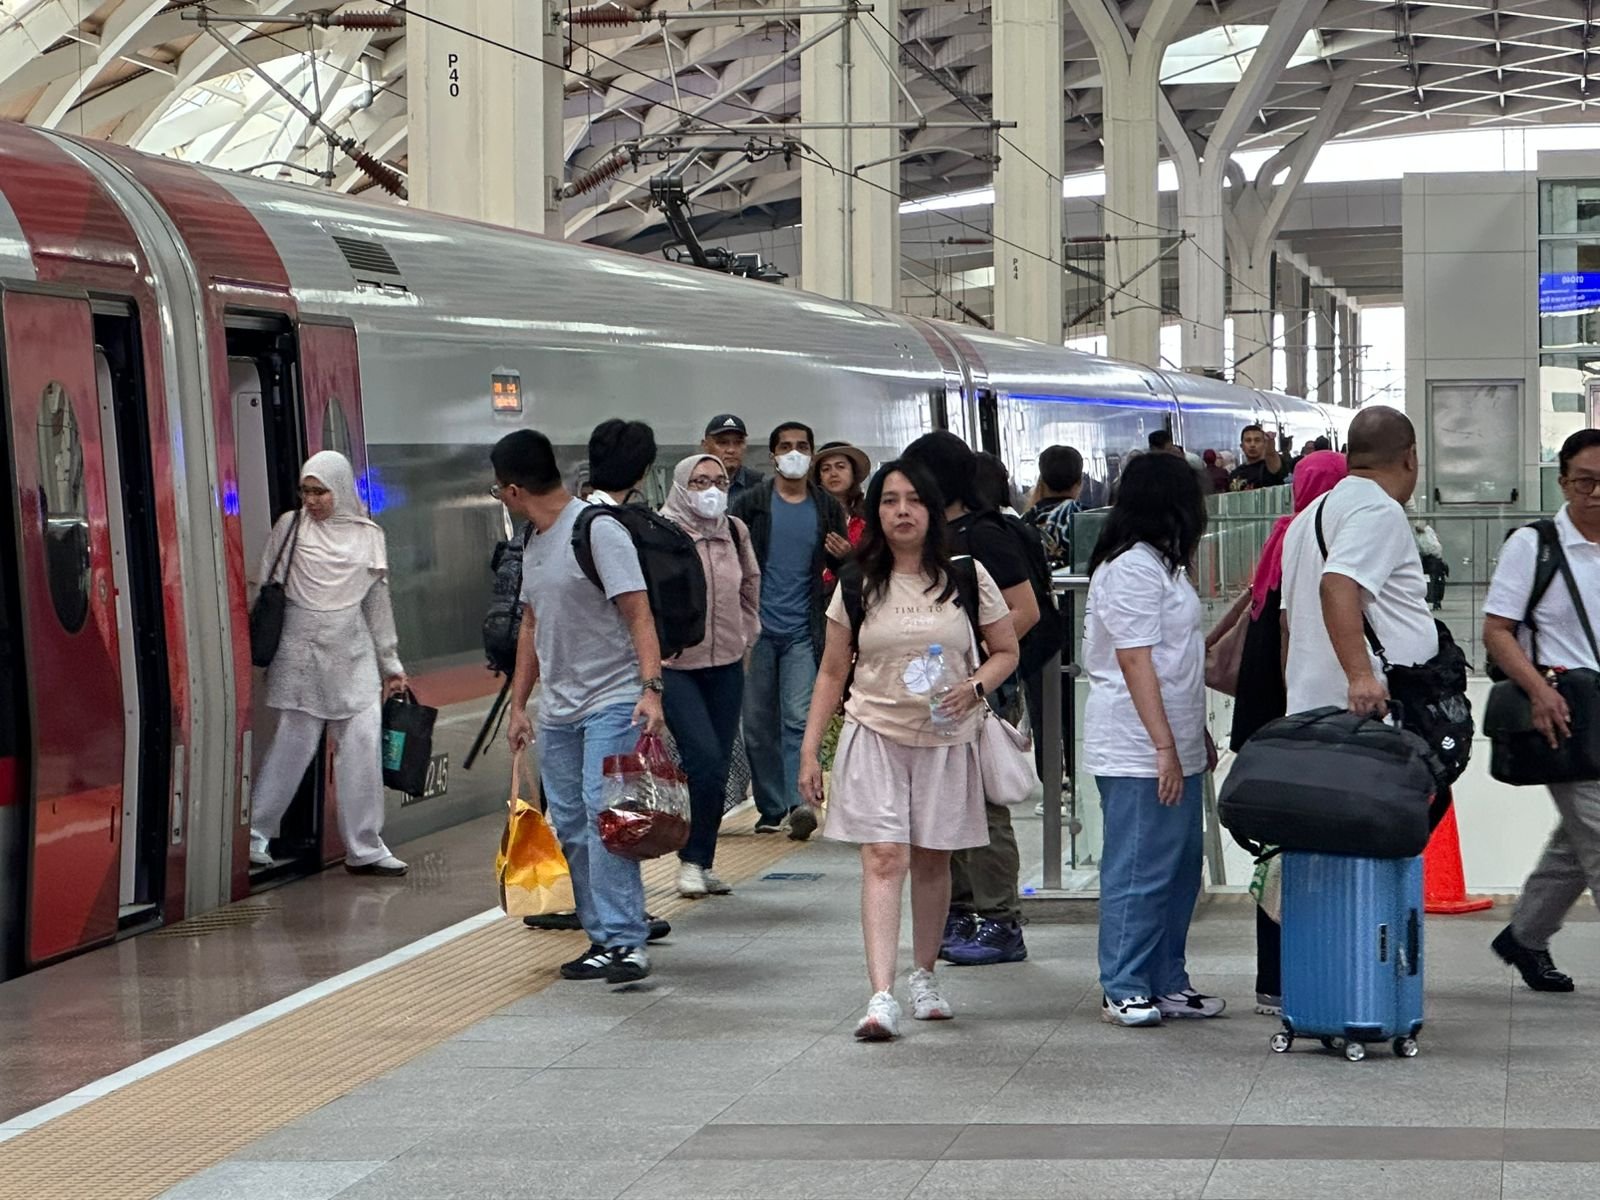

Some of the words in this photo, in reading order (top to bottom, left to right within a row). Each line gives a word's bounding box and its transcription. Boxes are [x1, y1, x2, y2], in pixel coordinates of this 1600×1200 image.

[448, 53, 459, 97] P40
[895, 606, 920, 614] TIME
[928, 605, 943, 613] TO
